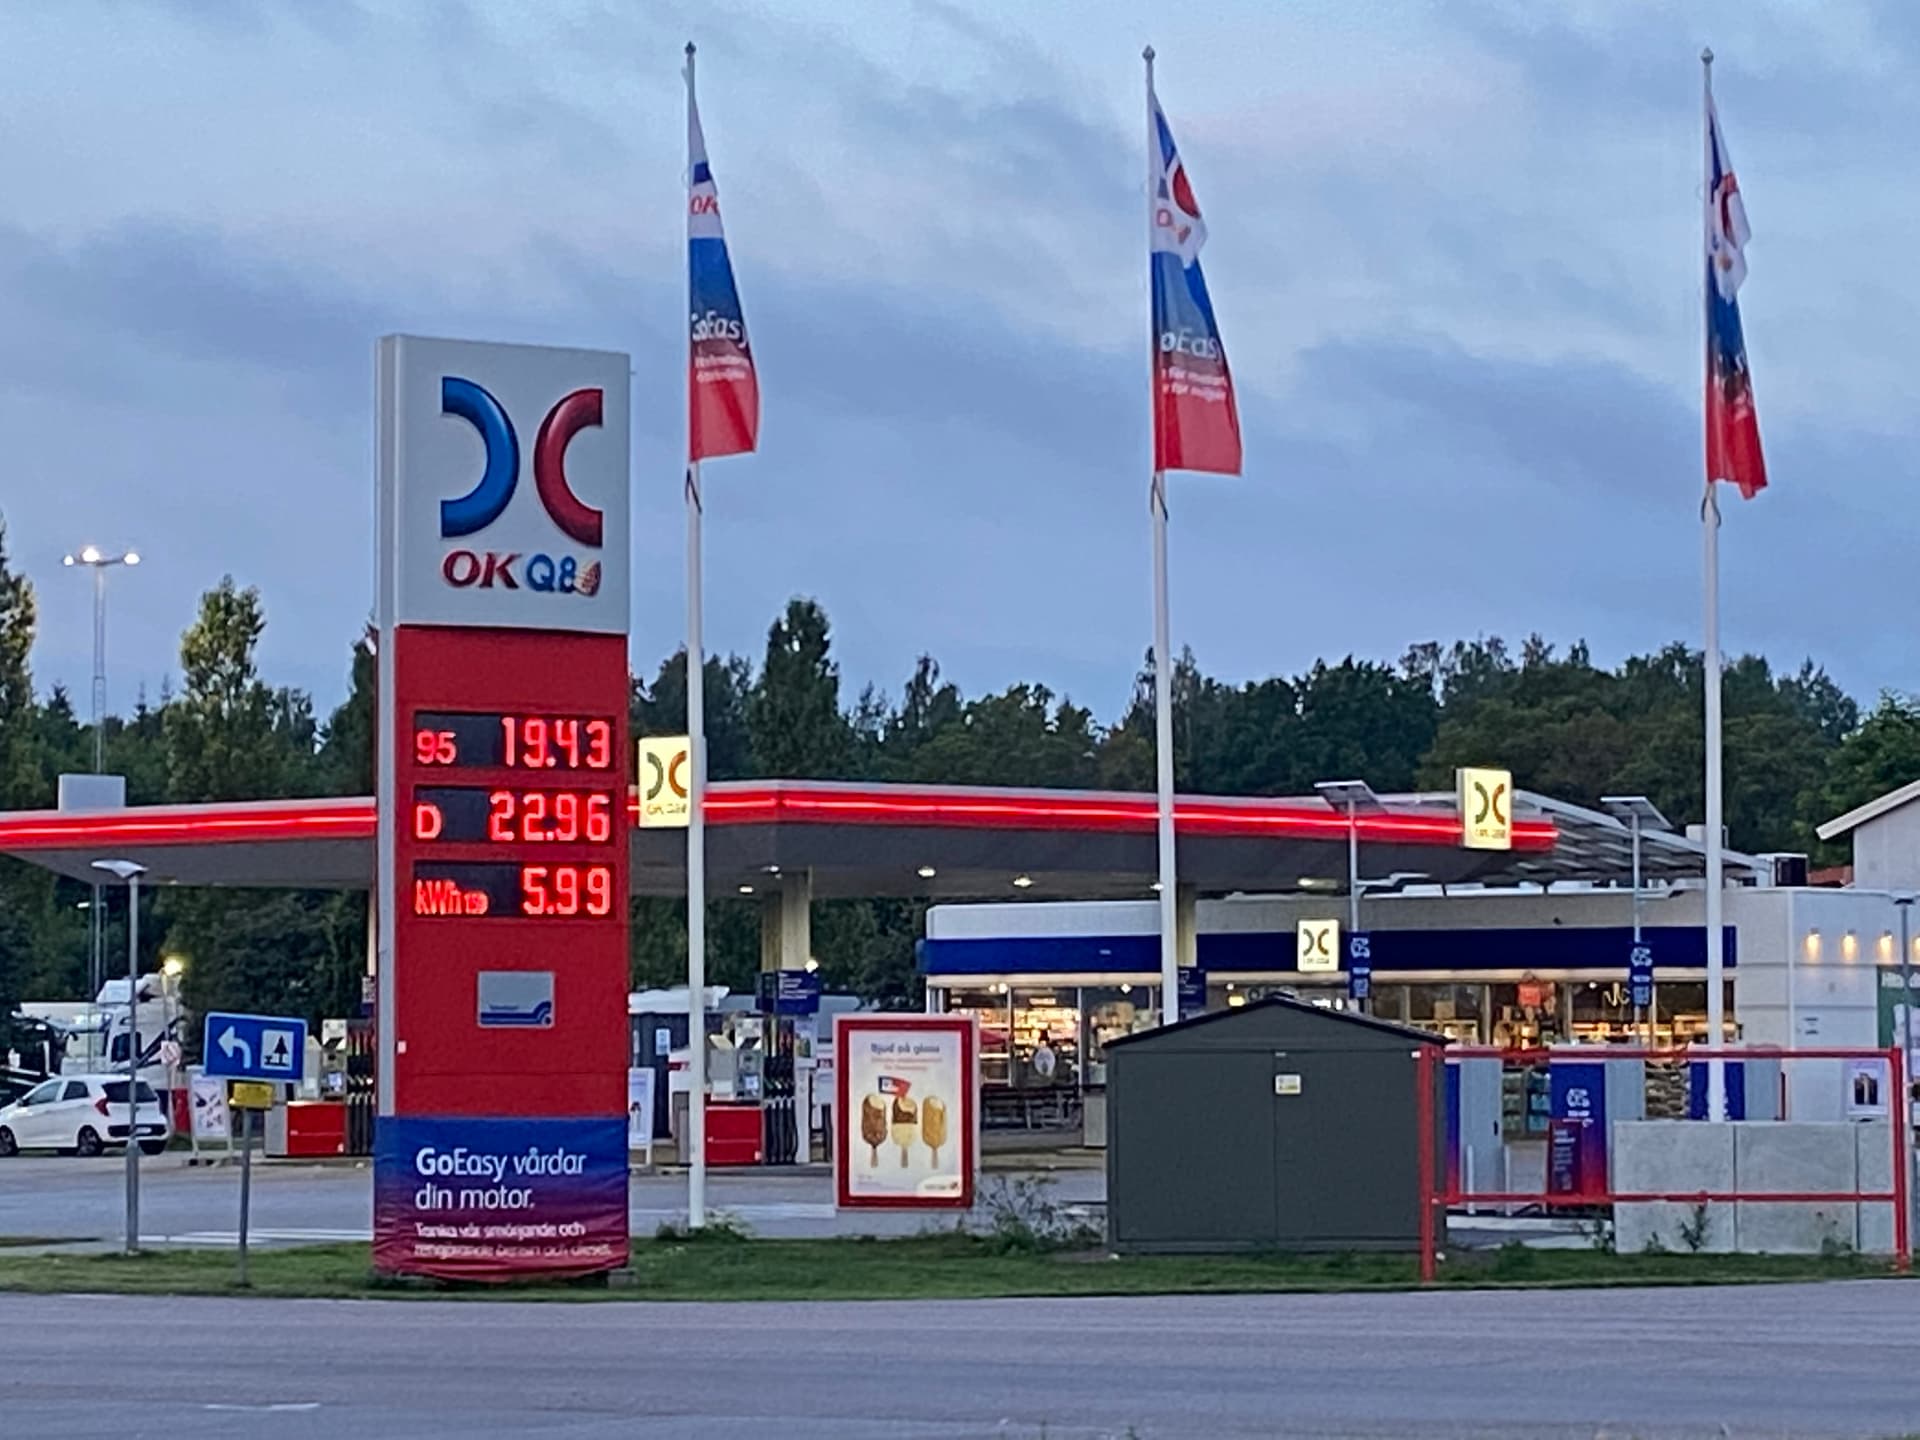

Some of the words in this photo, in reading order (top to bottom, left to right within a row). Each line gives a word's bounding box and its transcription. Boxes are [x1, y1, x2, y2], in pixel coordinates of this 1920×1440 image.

[416, 730, 456, 764] 95
[502, 717, 610, 768] 19.43
[415, 804, 442, 839] D
[490, 790, 610, 841] 22.96
[523, 867, 611, 915] 5.99
[416, 1147, 508, 1182] GoEasy
[512, 1147, 587, 1175] vårdar
[415, 1183, 452, 1209] din
[460, 1185, 535, 1209] motor.
[558, 1221, 586, 1237] och
